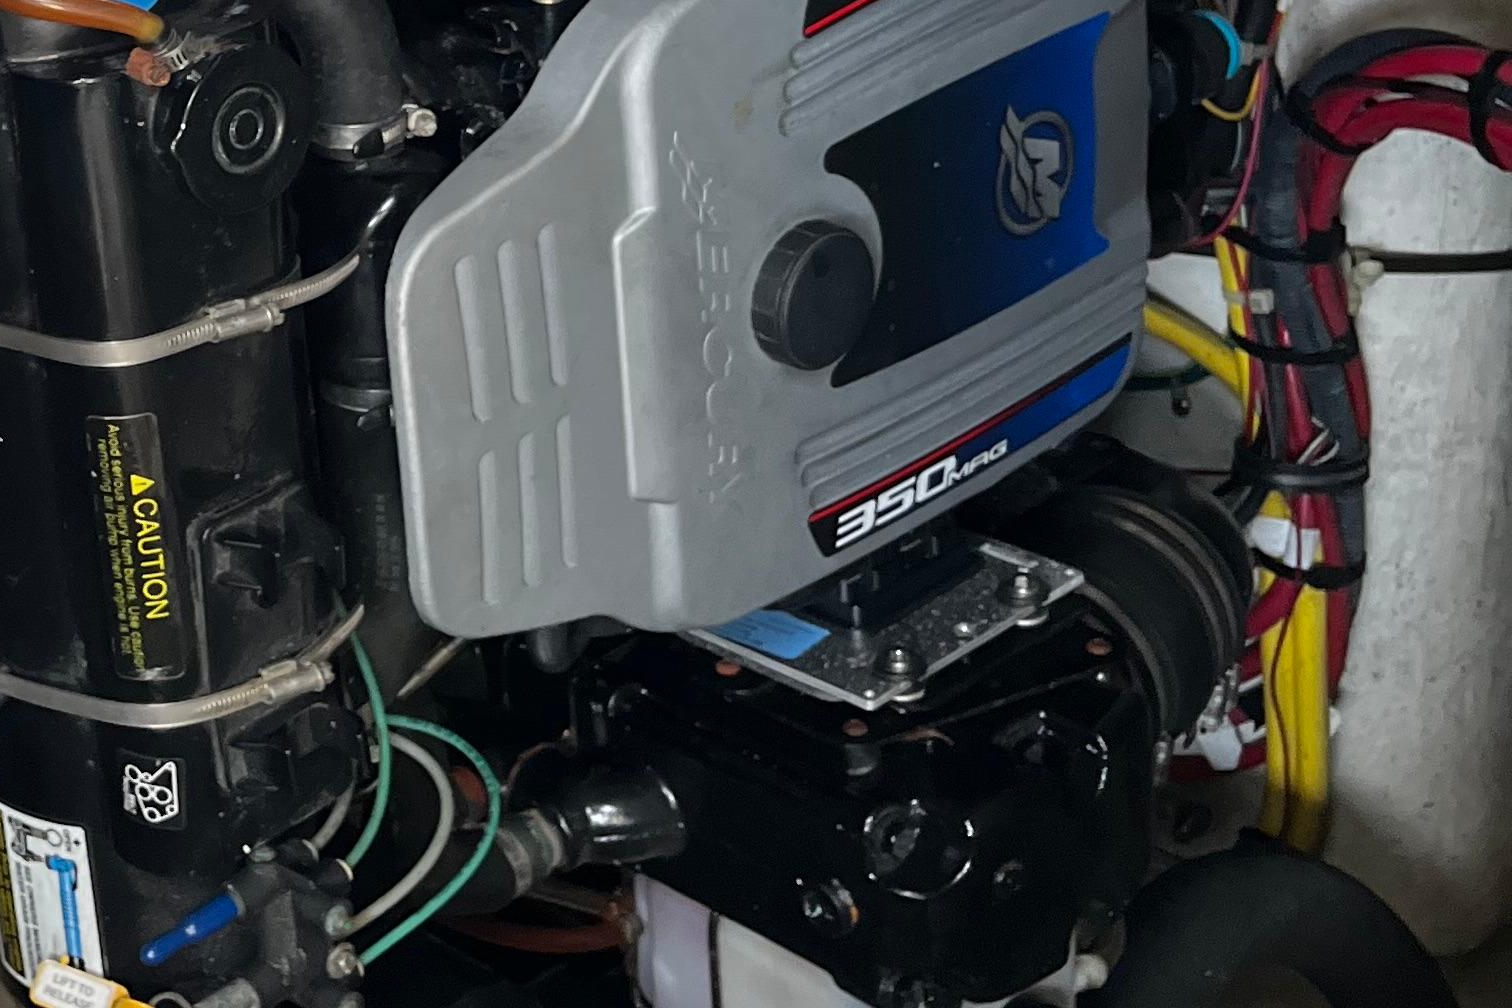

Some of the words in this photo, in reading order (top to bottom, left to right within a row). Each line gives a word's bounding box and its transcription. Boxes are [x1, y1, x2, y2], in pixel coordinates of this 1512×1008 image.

[108, 424, 122, 456] Avoid
[98, 438, 112, 492] removing
[111, 460, 125, 501] serious
[121, 539, 133, 565] from
[133, 498, 169, 619] CAUTION
[128, 606, 140, 629] Use
[53, 973, 76, 989] LIFT
[79, 983, 95, 997] TO
